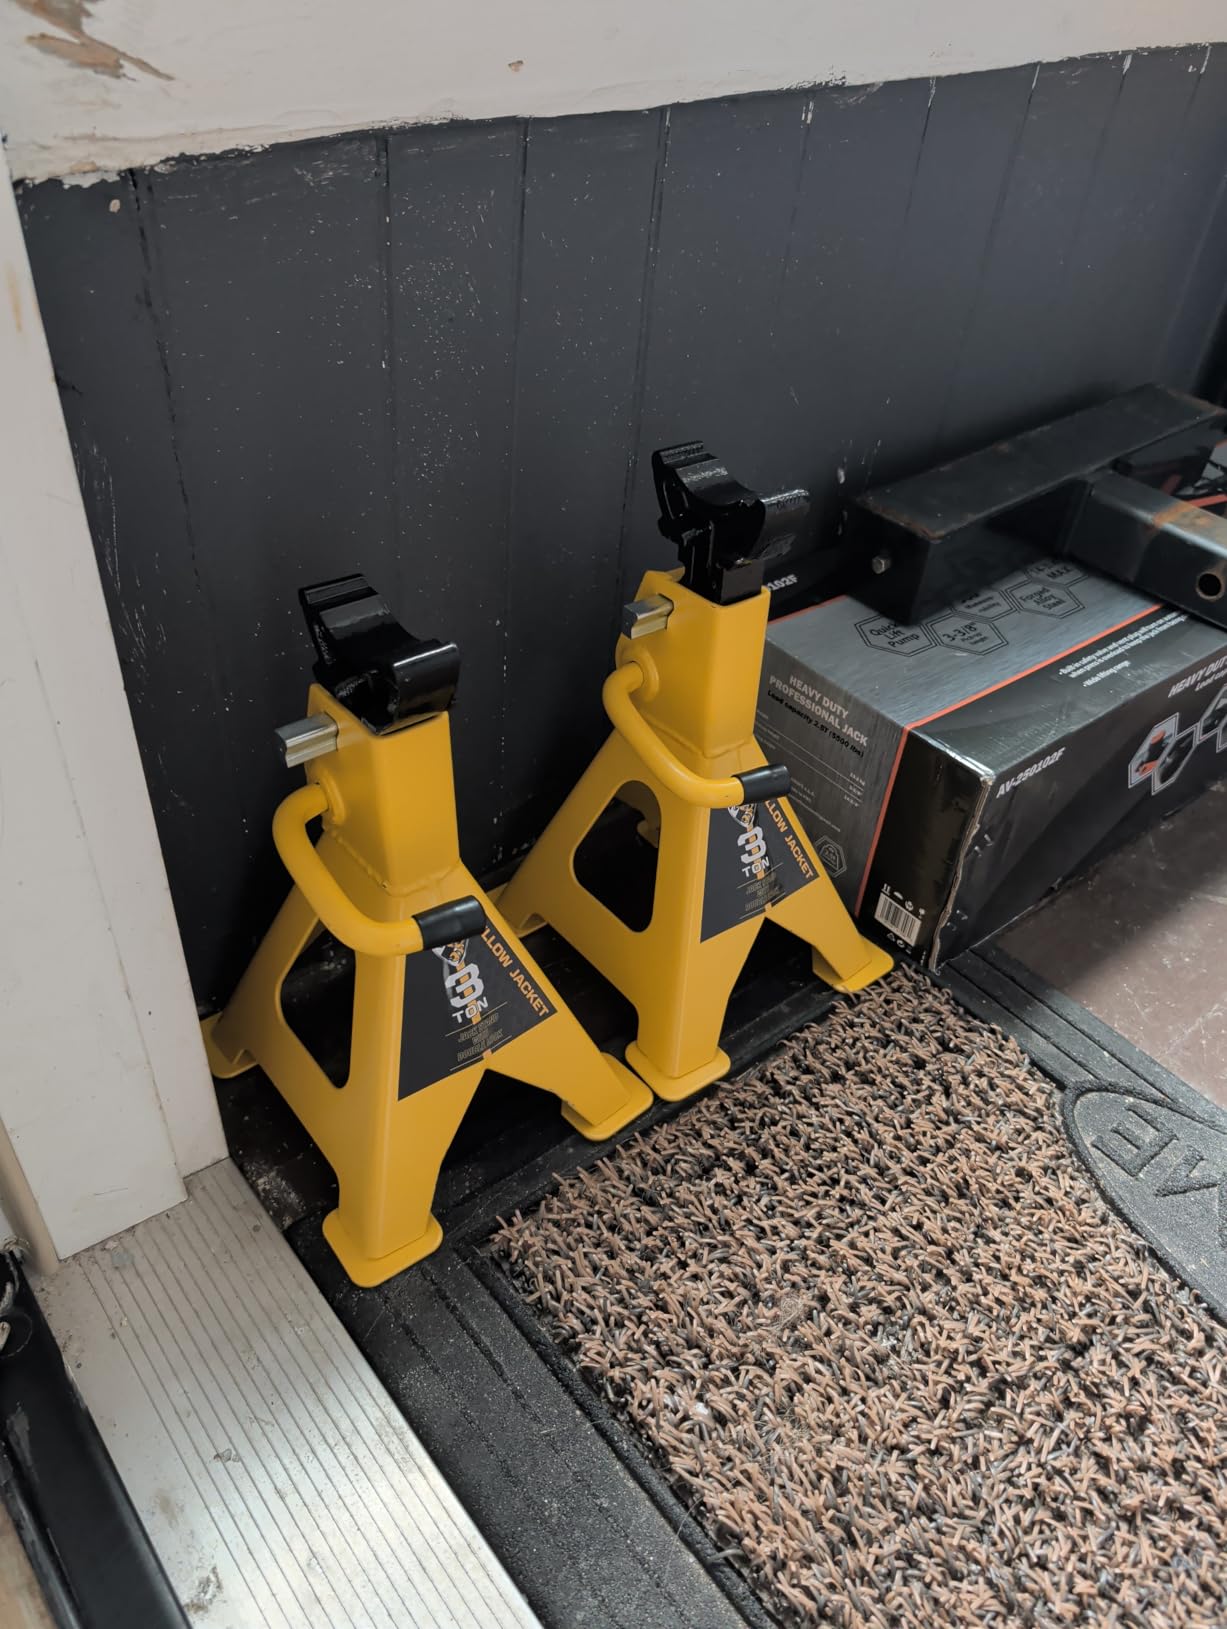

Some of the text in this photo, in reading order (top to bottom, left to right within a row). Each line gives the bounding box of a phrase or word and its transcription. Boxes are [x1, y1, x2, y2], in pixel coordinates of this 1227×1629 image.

[767, 574, 797, 591] 102F
[888, 633, 920, 648] Pump
[789, 675, 849, 719] HEAVY DUTY
[1168, 655, 1227, 698] HEAVY DUT
[769, 675, 868, 746] PROFESSIONAL JACK
[996, 747, 1066, 798] AV-250102F
[737, 826, 767, 864] 3
[765, 800, 788, 833] LLOW
[784, 834, 814, 878] JACKET
[741, 856, 770, 877] TON
[445, 963, 485, 1008] 3
[481, 926, 549, 1017] LLOW JACKET
[452, 996, 489, 1023] TON
